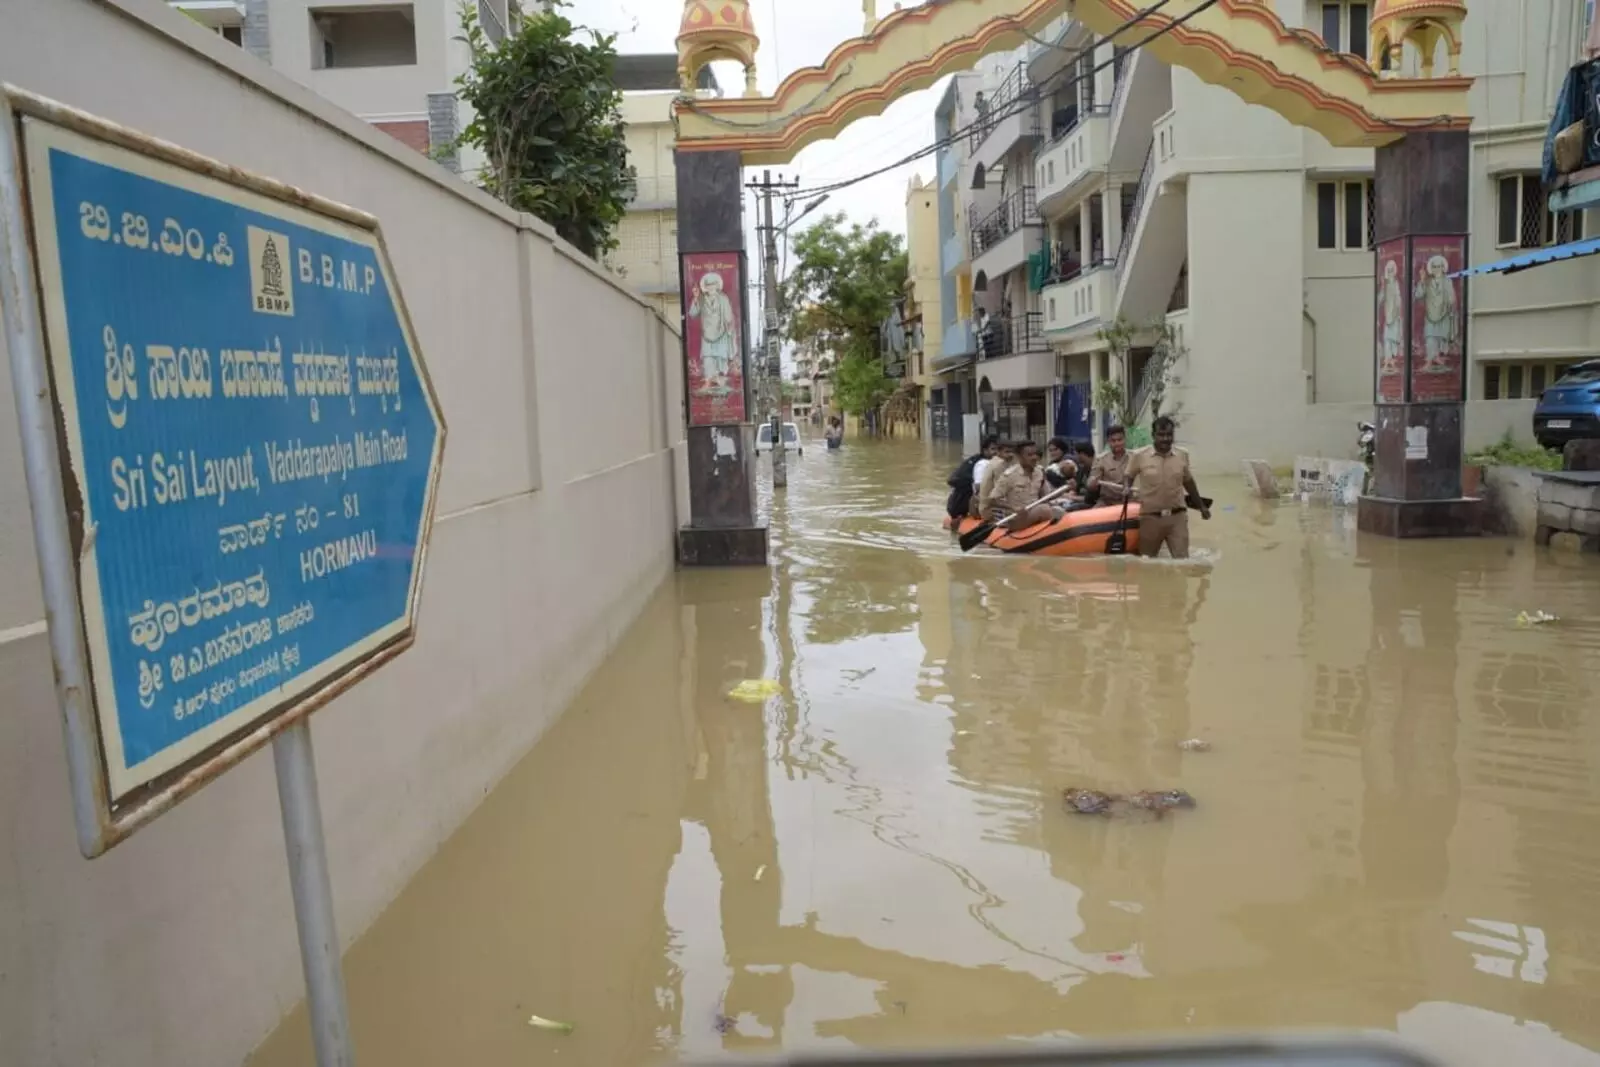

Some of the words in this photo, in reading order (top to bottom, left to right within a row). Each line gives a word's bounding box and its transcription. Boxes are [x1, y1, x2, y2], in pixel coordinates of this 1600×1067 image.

[298, 248, 376, 295] B.B.M.P
[257, 297, 290, 312] BBMP
[103, 324, 138, 429] ಶ್ರೀ
[146, 344, 212, 399] ಸಾಯಿ
[111, 454, 148, 512] Sri
[151, 451, 187, 504] Sai
[190, 448, 260, 507] Layout,
[265, 438, 354, 484] Vaddarapalya
[355, 431, 381, 467] Main
[382, 428, 407, 462] Road
[218, 511, 287, 554] ವಾರ್ಡ್
[343, 492, 360, 519] 81
[300, 528, 377, 584] HORMAVU
[129, 565, 270, 651] ಹೊರಮಾವು
[138, 659, 164, 709] ಶ್ರೀ
